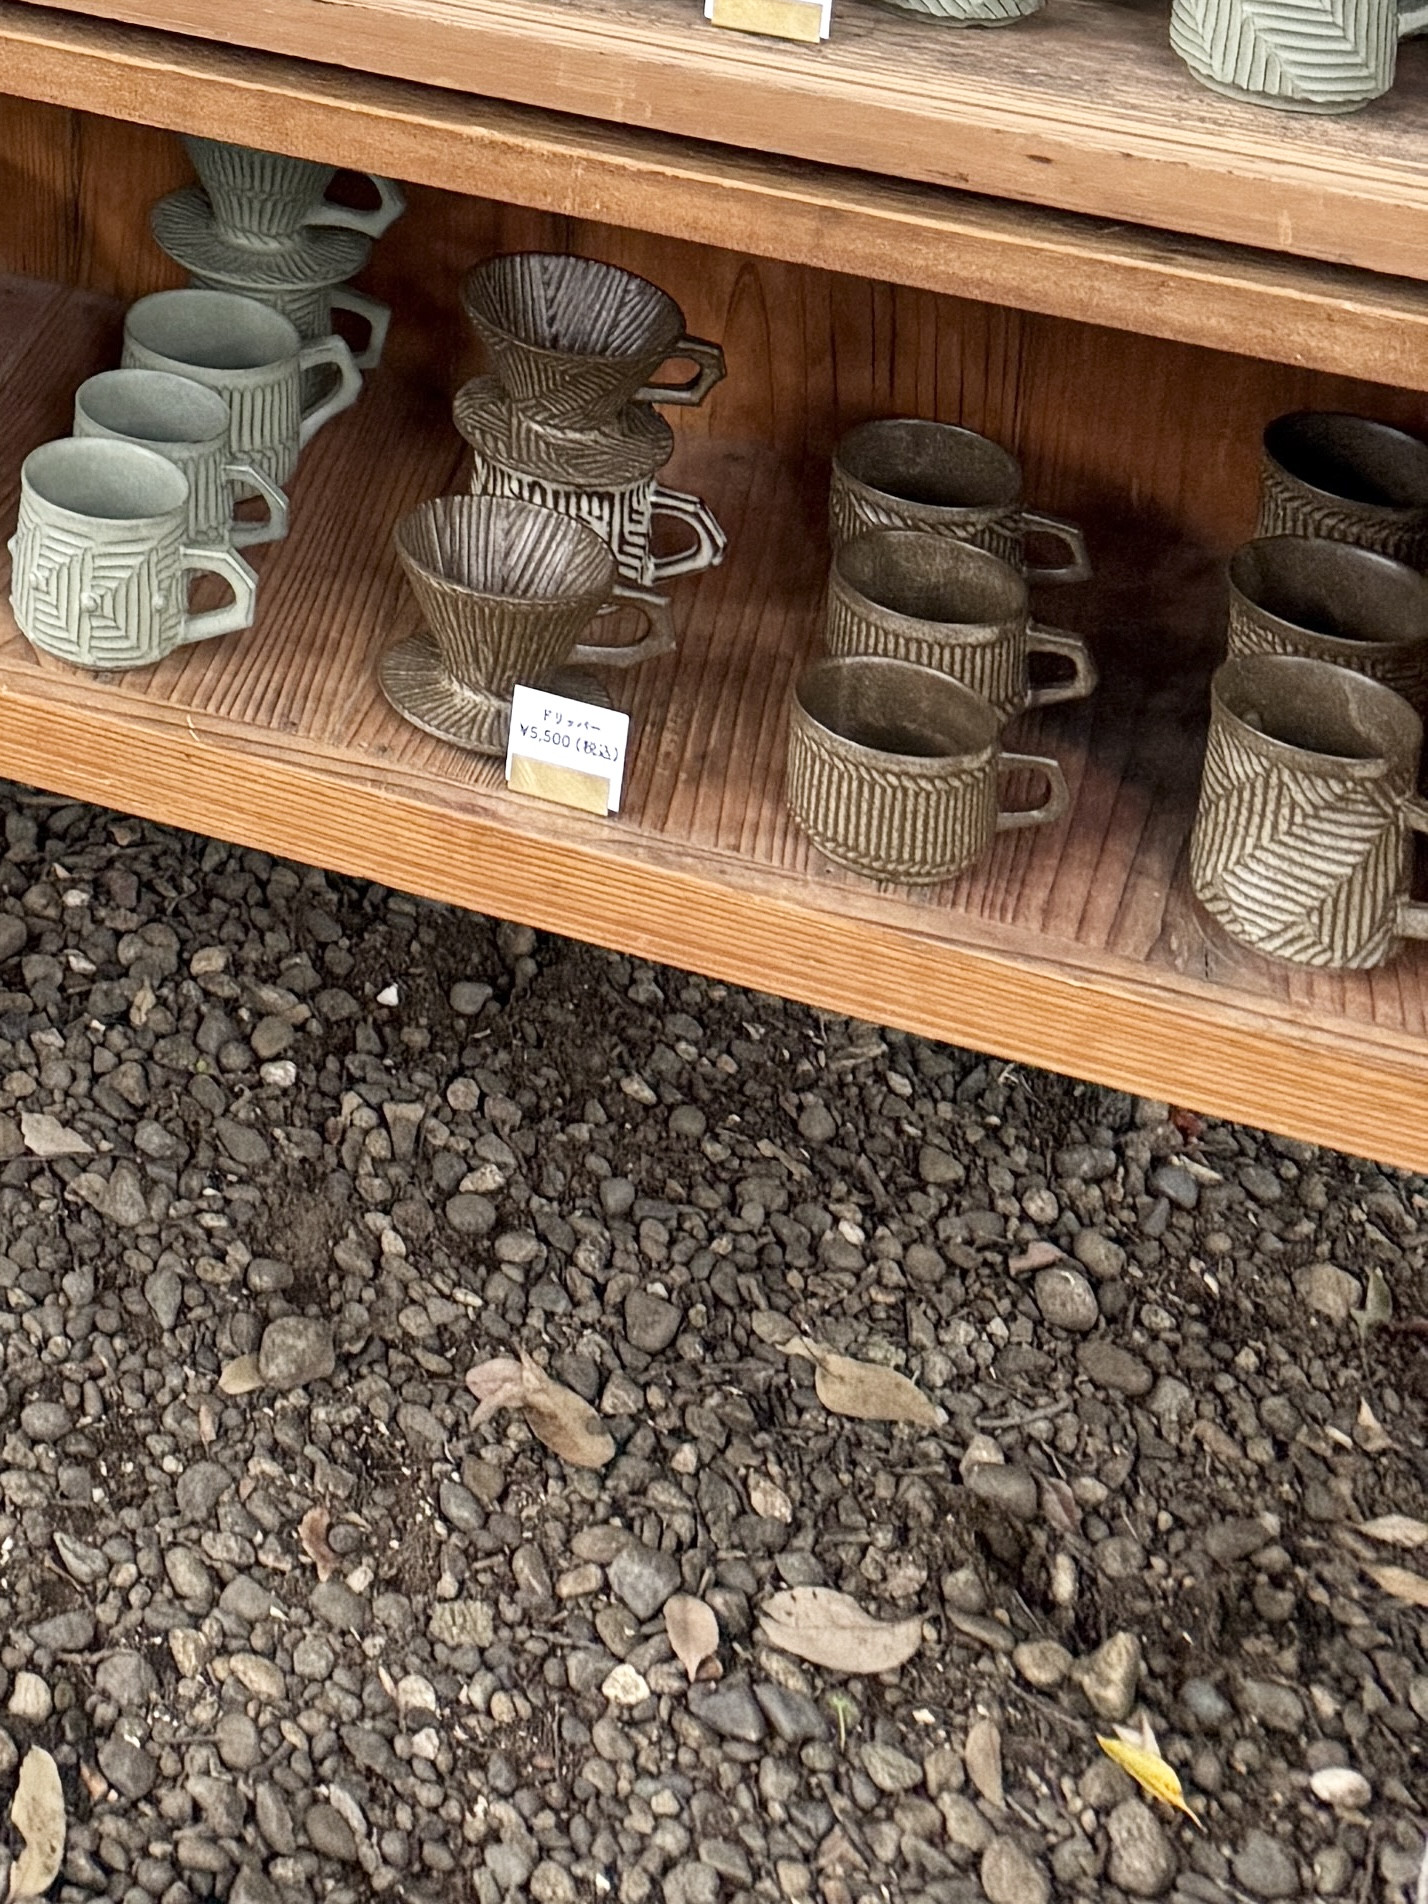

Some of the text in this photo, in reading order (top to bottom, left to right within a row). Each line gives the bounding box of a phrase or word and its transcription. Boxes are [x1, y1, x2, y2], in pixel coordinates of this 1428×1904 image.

[543, 708, 601, 731] ドリッパー
